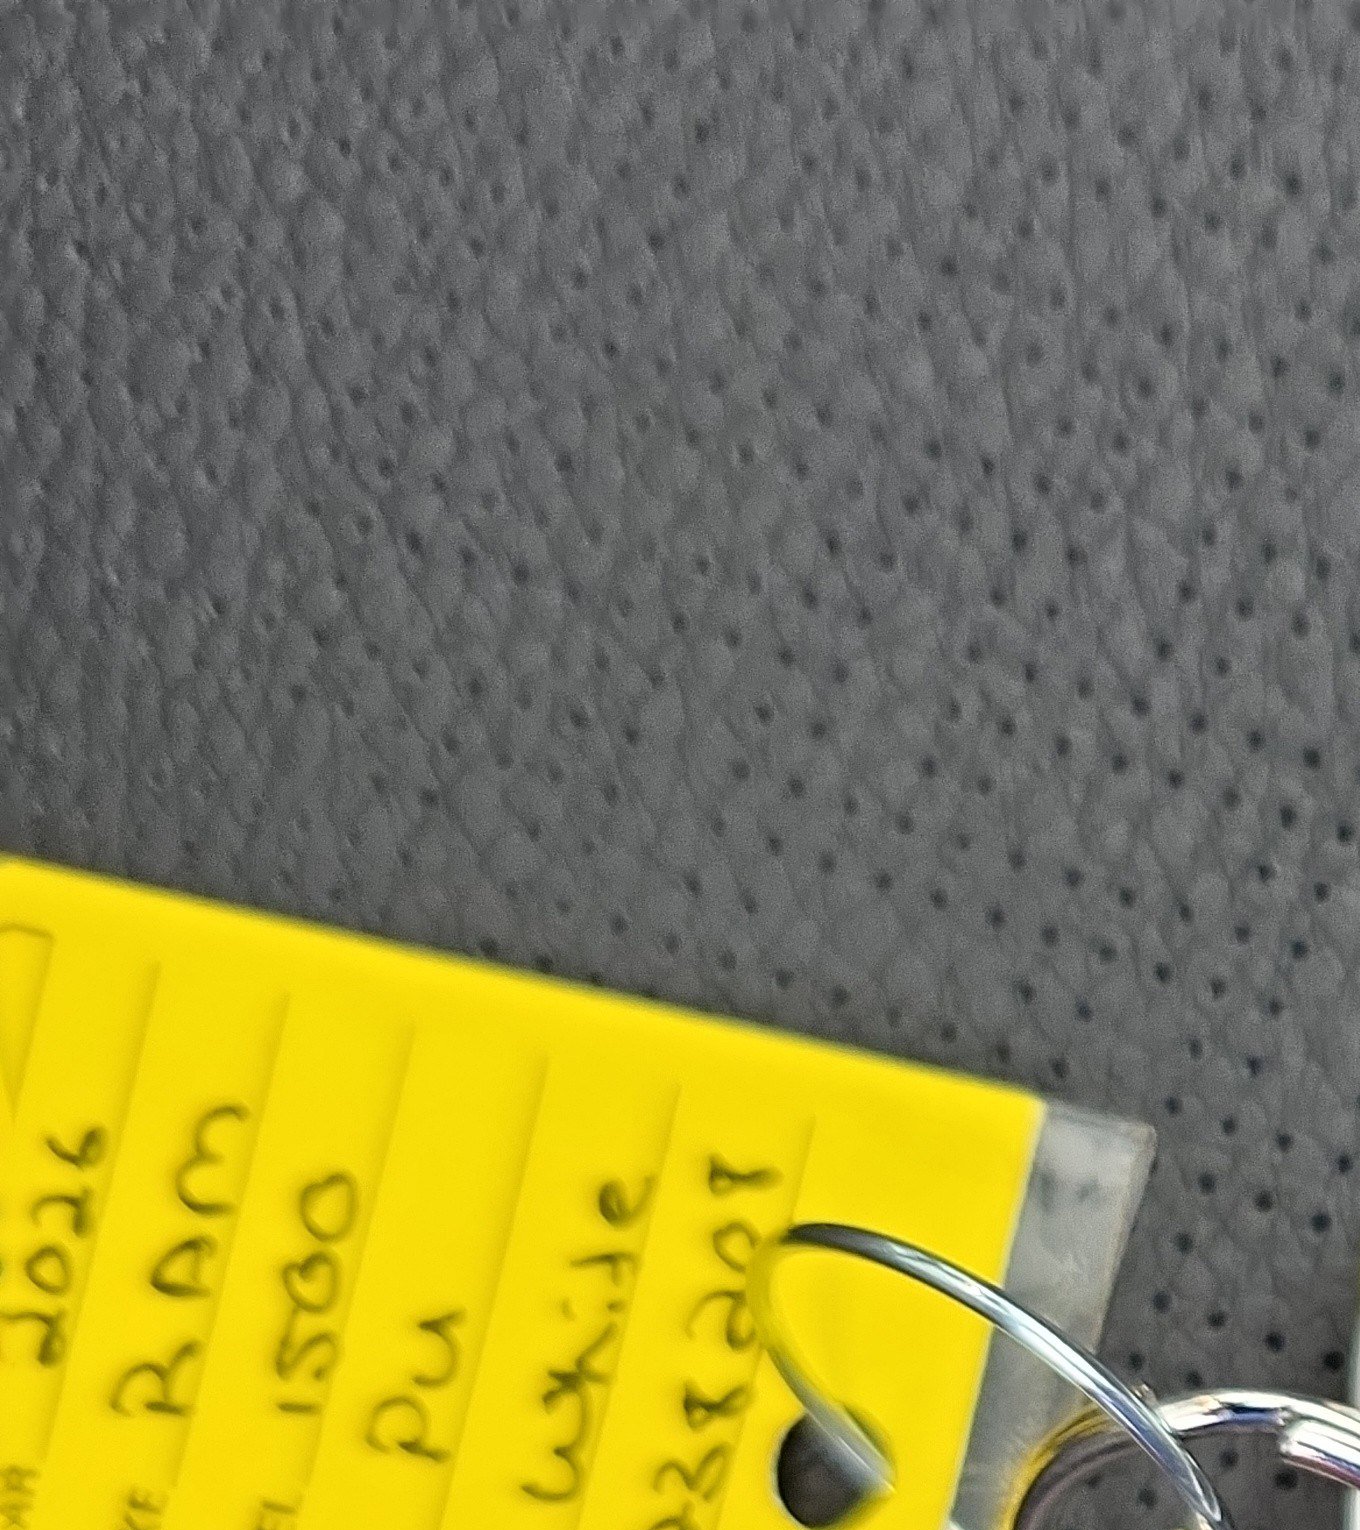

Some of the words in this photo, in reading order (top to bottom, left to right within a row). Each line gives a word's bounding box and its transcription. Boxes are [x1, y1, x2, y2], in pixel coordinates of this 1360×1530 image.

[0, 1122, 106, 1368] 2026
[109, 1102, 252, 1418] RAM
[275, 1170, 359, 1417] 1500
